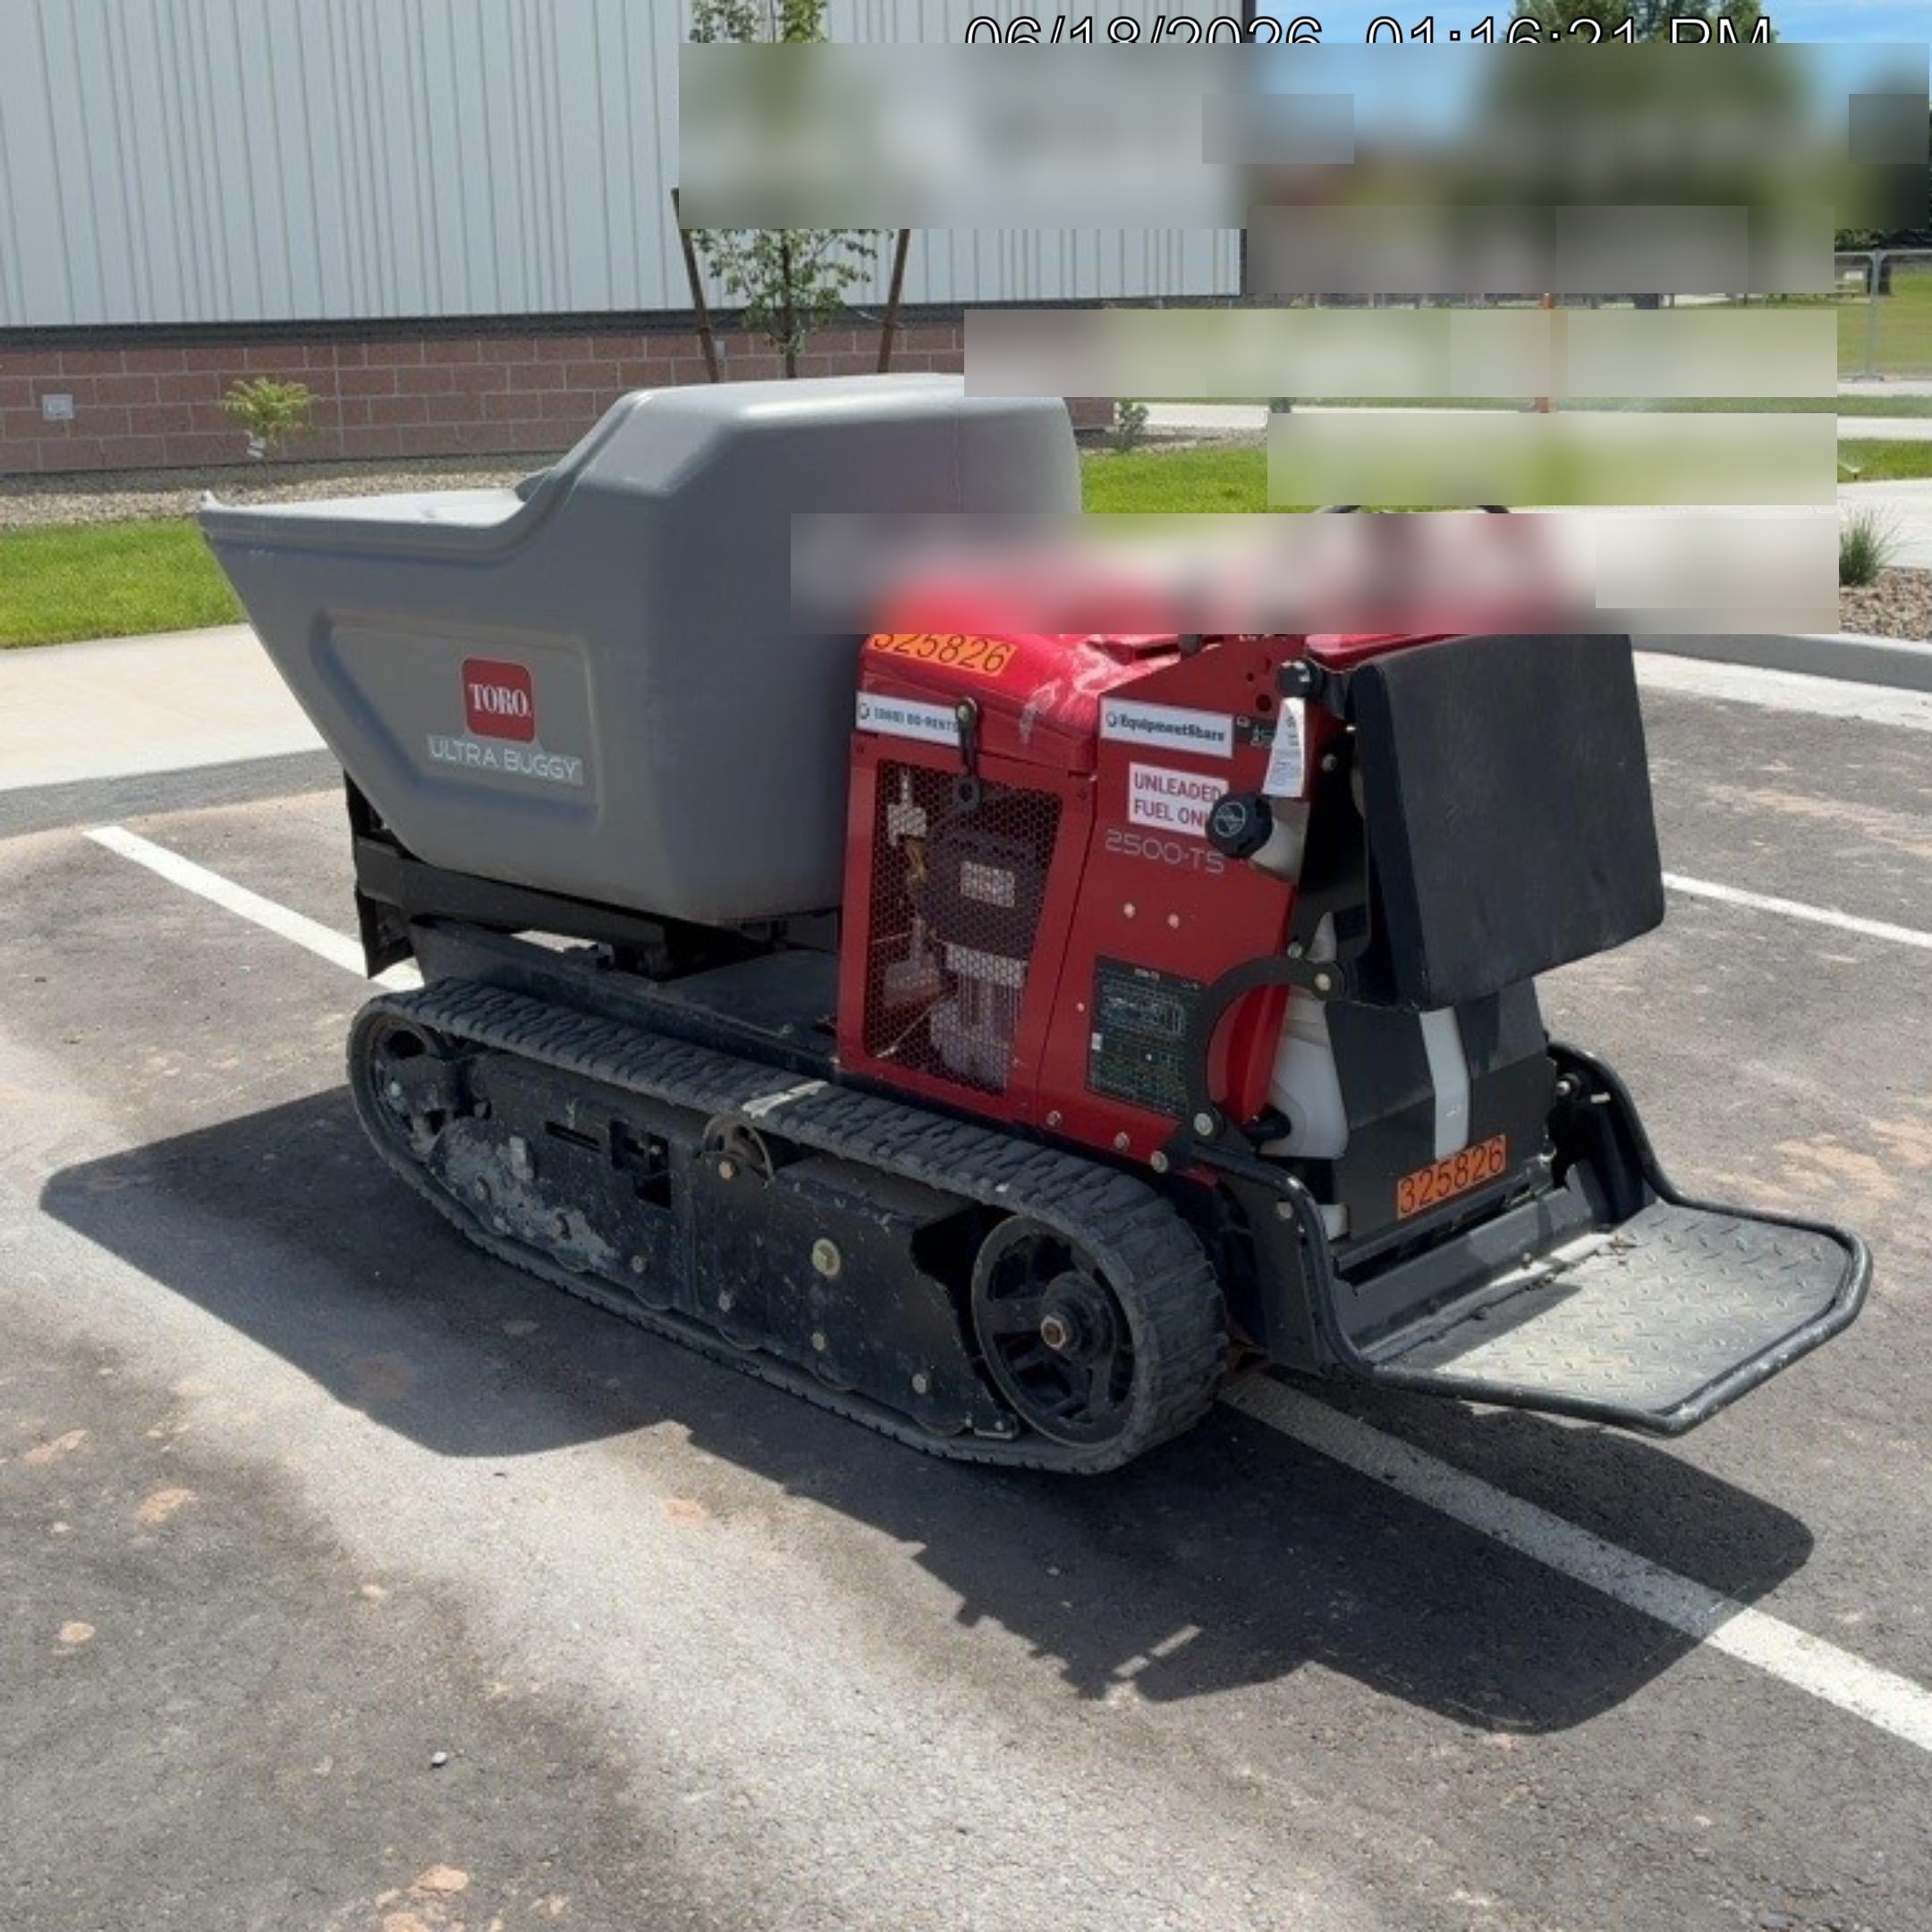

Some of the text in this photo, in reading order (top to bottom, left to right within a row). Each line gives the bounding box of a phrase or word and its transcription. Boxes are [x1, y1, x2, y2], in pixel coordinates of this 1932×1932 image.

[1118, 713, 1225, 741] EquipmentShare
[427, 733, 581, 780] ULTRA BUGGY
[1134, 799, 1174, 822] FUEL
[1400, 1137, 1503, 1213] 325826
